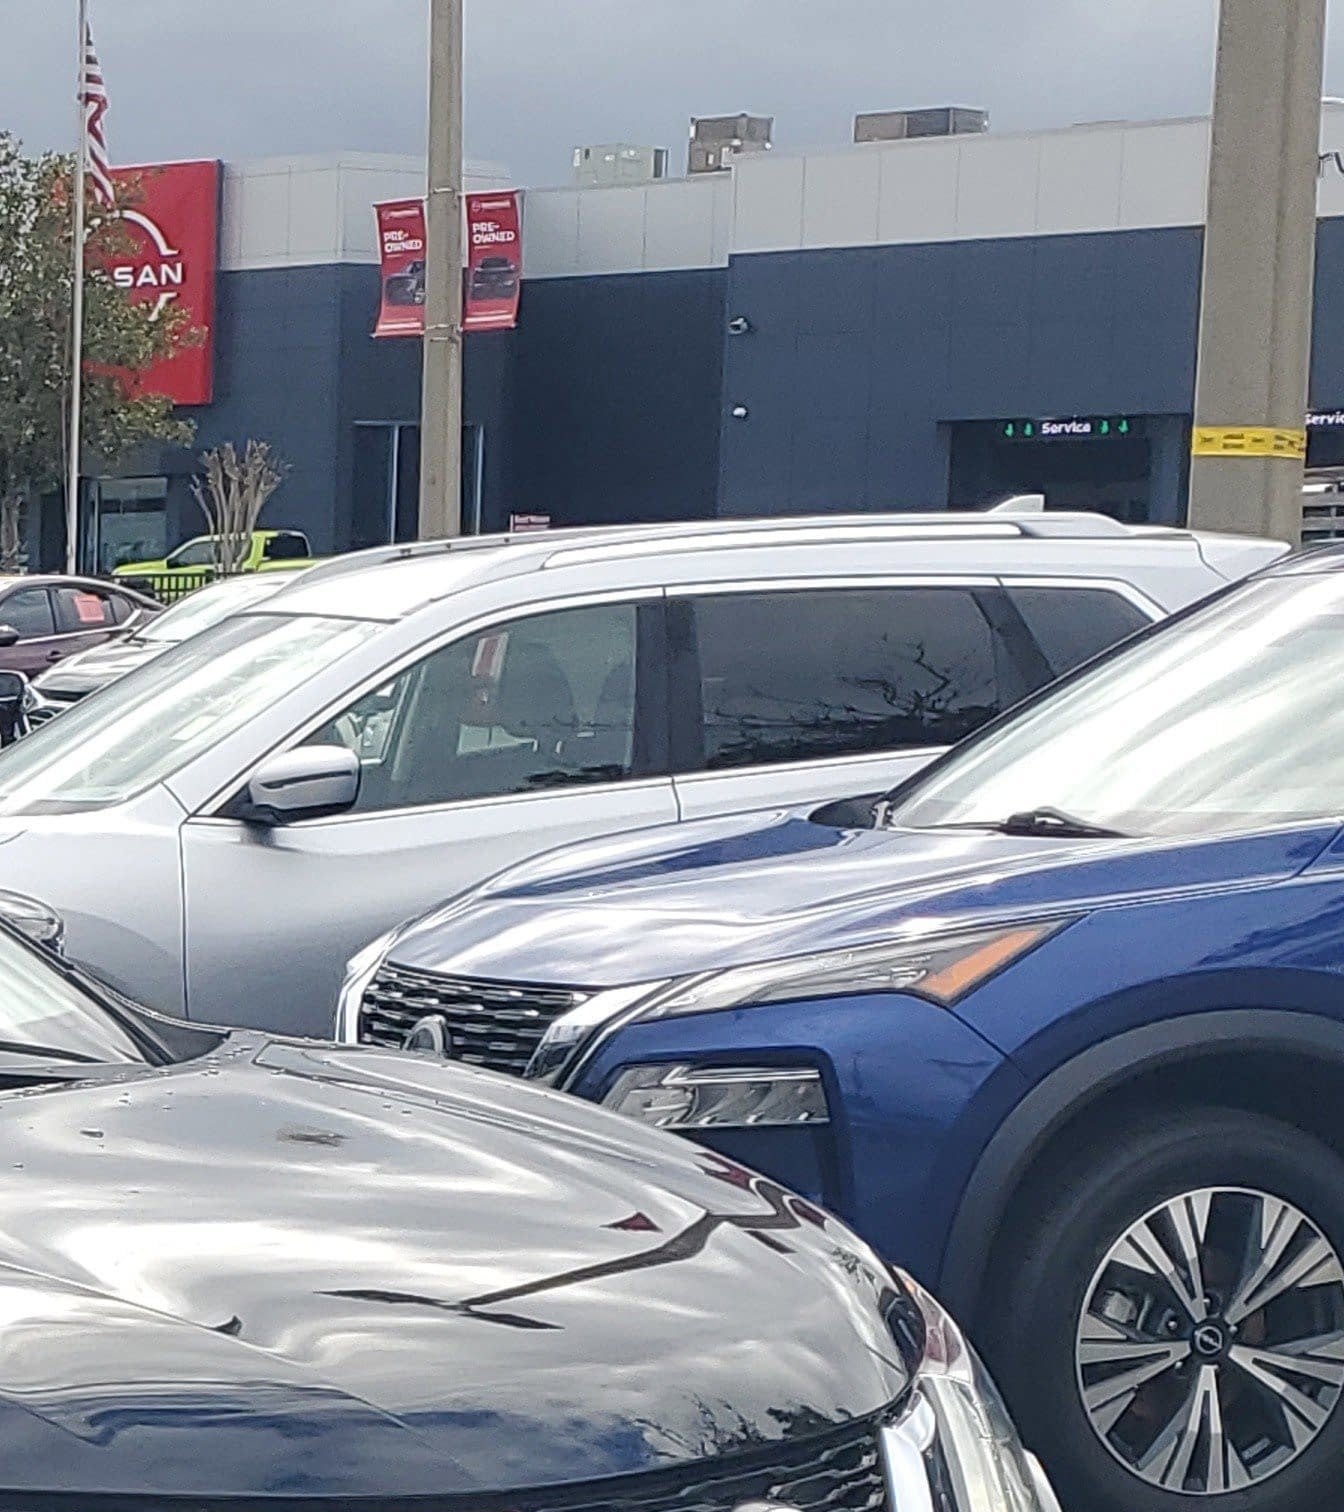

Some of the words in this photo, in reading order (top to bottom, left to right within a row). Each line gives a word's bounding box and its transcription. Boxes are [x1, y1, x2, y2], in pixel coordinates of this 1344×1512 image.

[472, 221, 500, 233] PRE-
[472, 230, 516, 244] OWNED
[1041, 420, 1092, 435] Service
